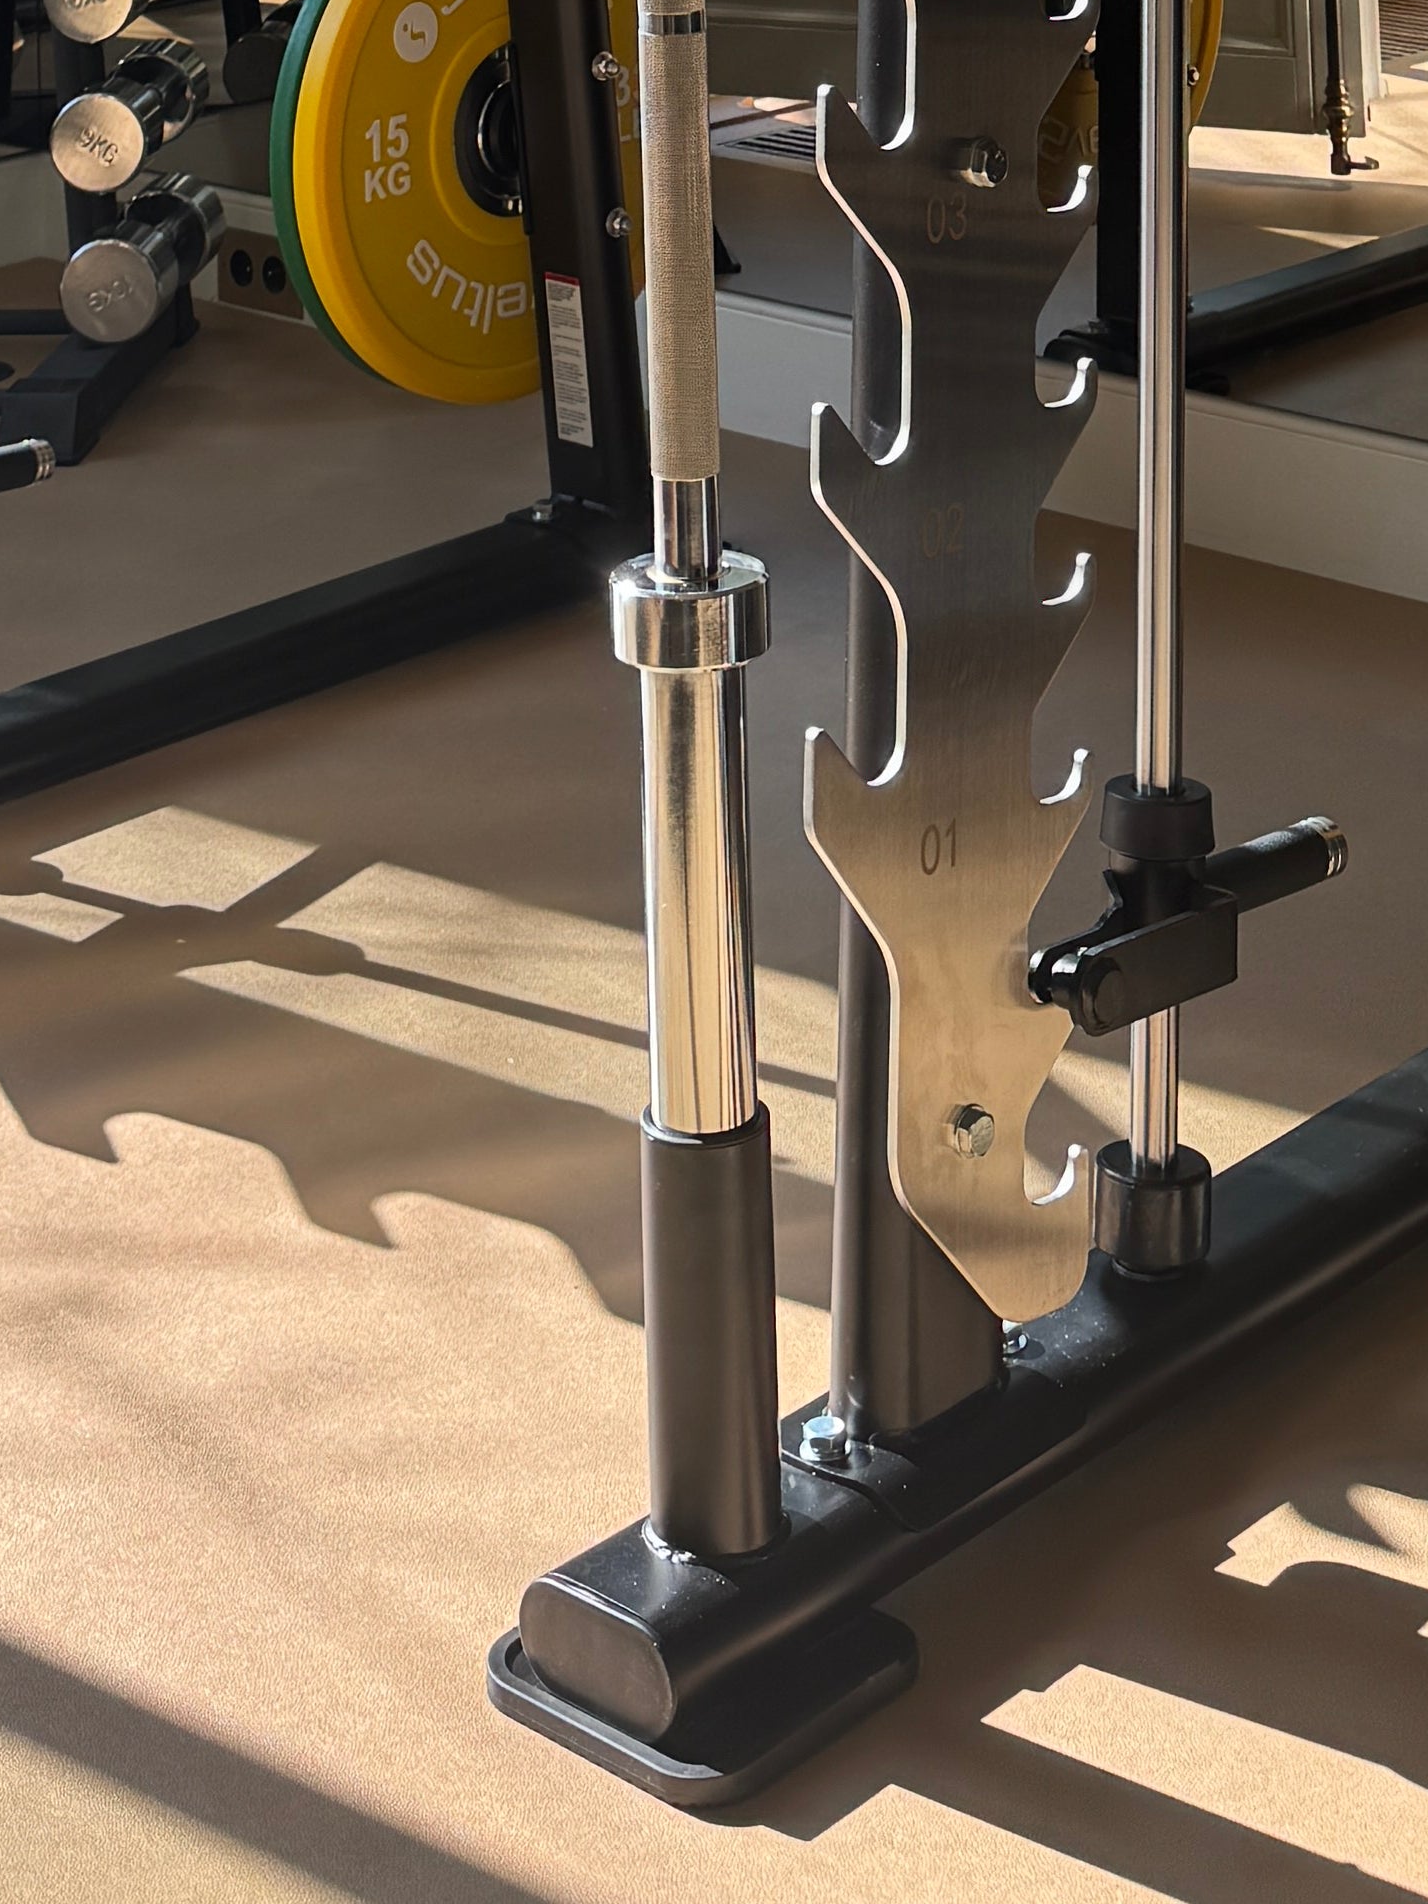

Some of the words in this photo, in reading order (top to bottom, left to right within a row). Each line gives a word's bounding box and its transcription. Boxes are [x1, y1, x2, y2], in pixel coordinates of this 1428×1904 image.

[364, 113, 410, 162] 15
[364, 162, 412, 203] KG
[925, 196, 968, 244] 03
[406, 239, 528, 334] eltus
[921, 504, 965, 559] 02
[920, 818, 958, 875] 01
